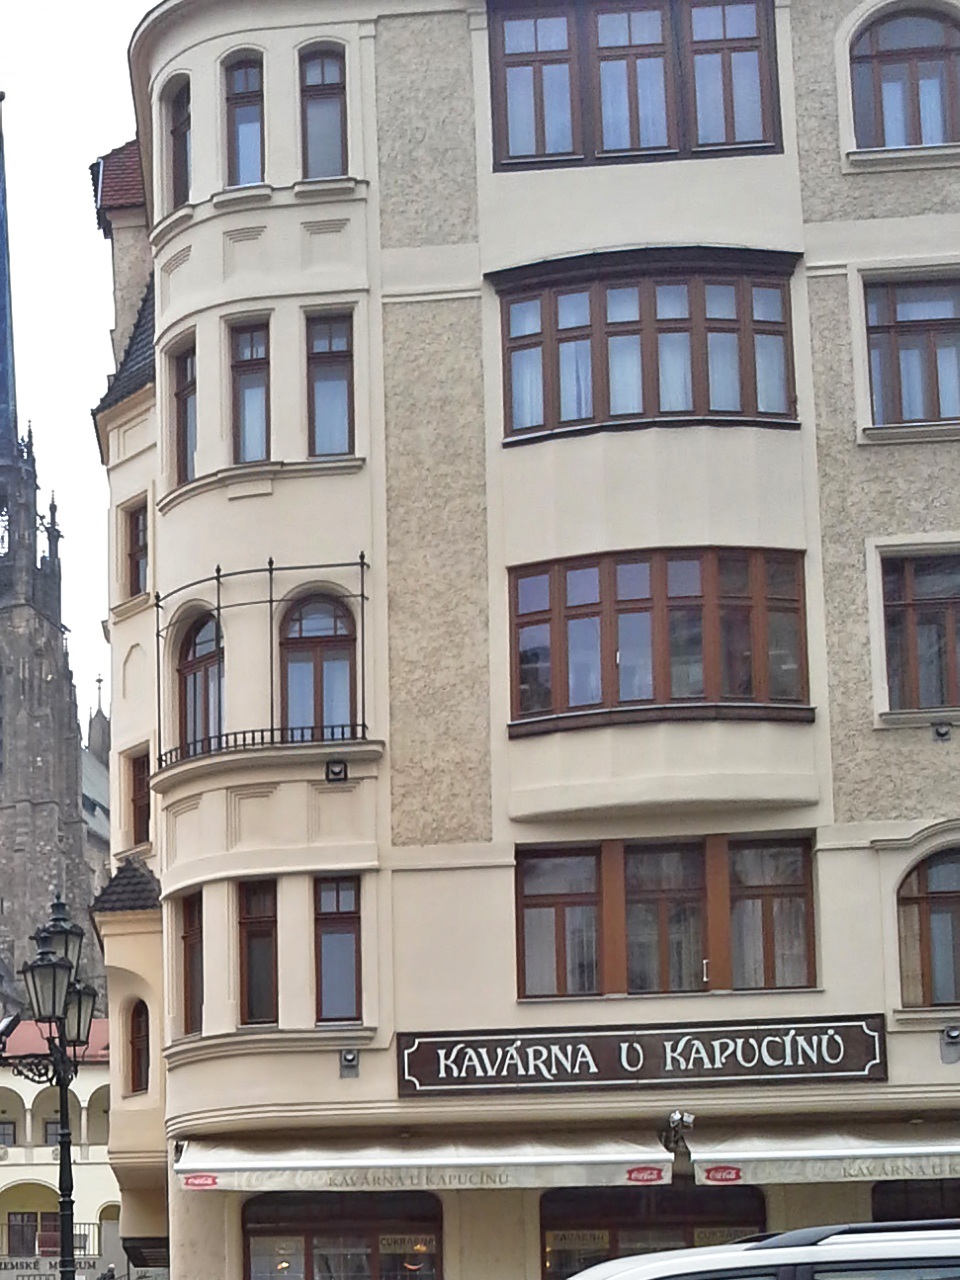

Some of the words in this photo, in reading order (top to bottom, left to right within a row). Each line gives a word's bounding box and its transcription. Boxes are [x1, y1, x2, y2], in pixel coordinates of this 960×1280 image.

[437, 1041, 598, 1081] KAVÁRNA
[619, 1043, 644, 1072] U
[664, 1029, 844, 1071] KAPUCÍNŮ
[410, 1174, 420, 1186] U
